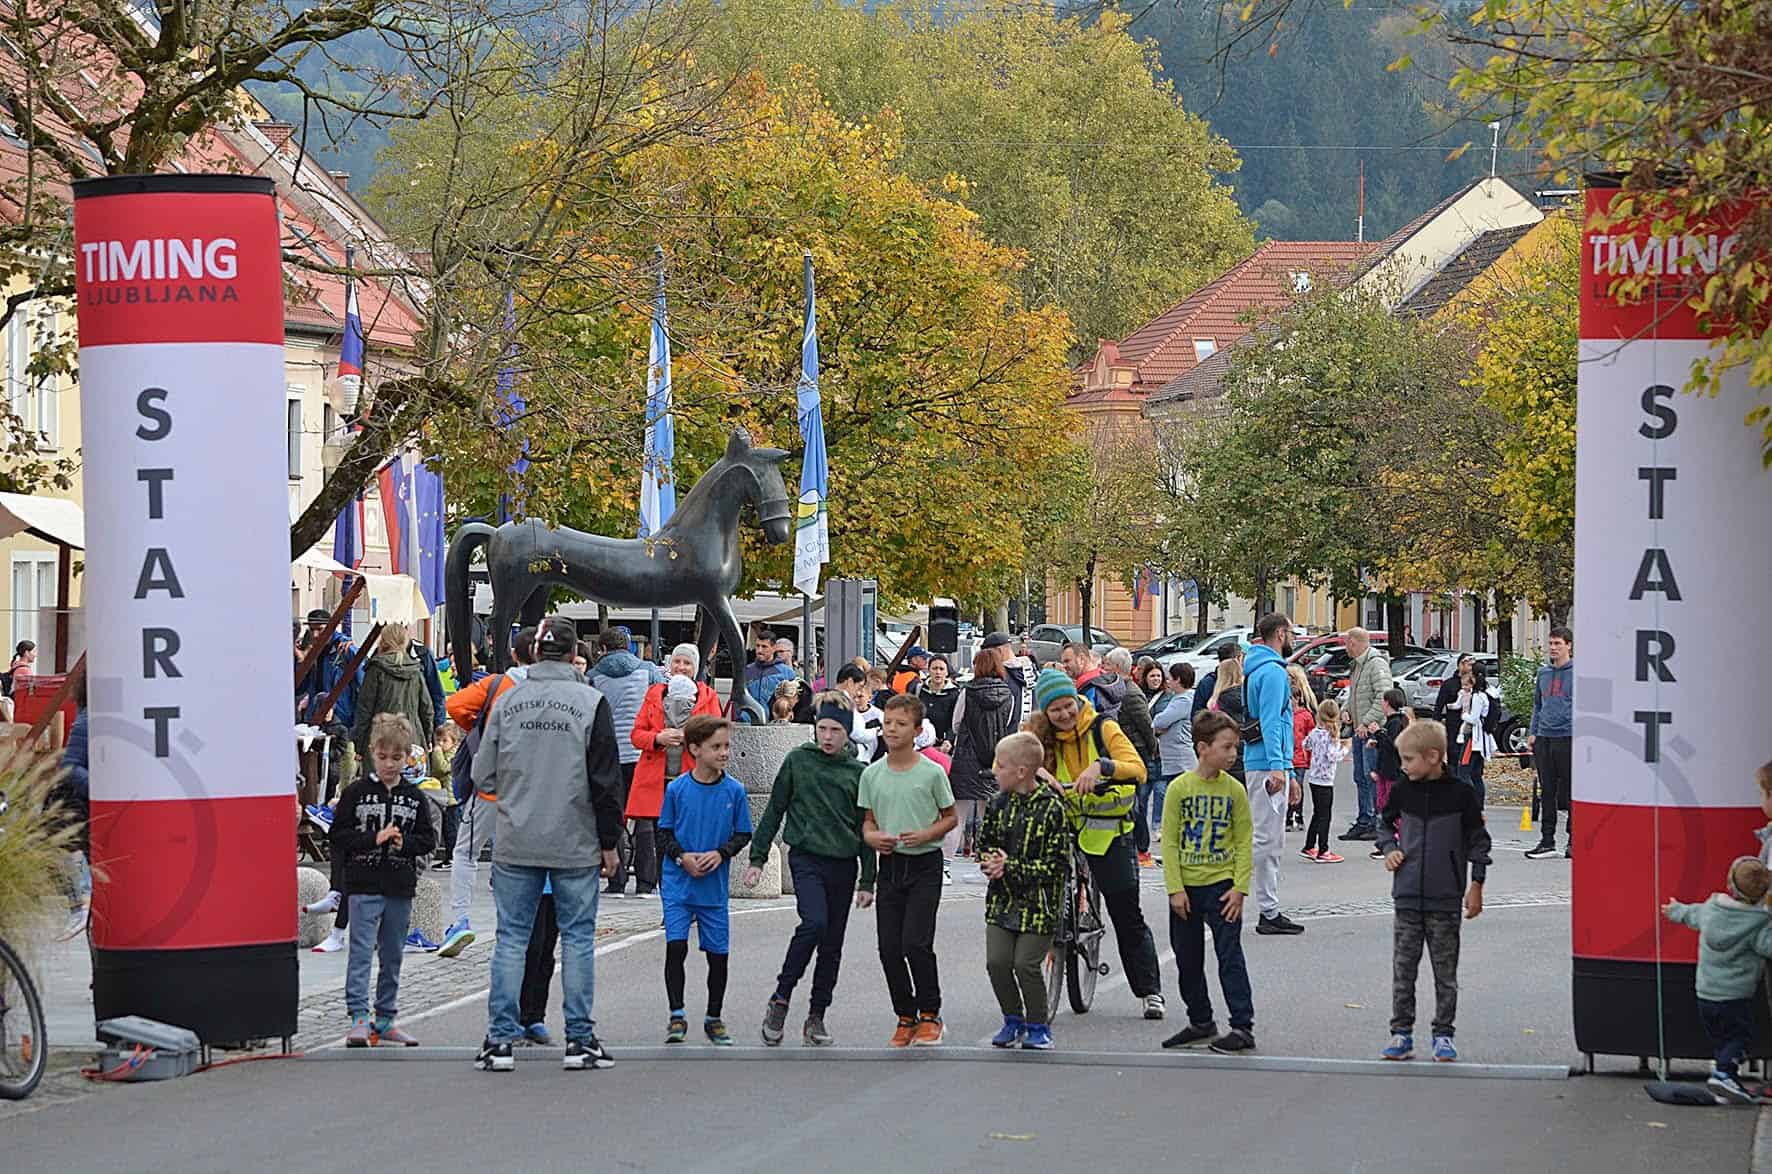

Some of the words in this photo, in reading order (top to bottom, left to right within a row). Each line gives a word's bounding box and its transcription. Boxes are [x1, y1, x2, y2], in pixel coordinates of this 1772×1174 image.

[81, 237, 238, 283] TIMING
[86, 284, 239, 306] LJUBLJANA
[134, 387, 185, 758] START
[1628, 384, 1683, 763] START
[519, 719, 572, 732] KOROŠKE
[1181, 820, 1229, 854] ME
